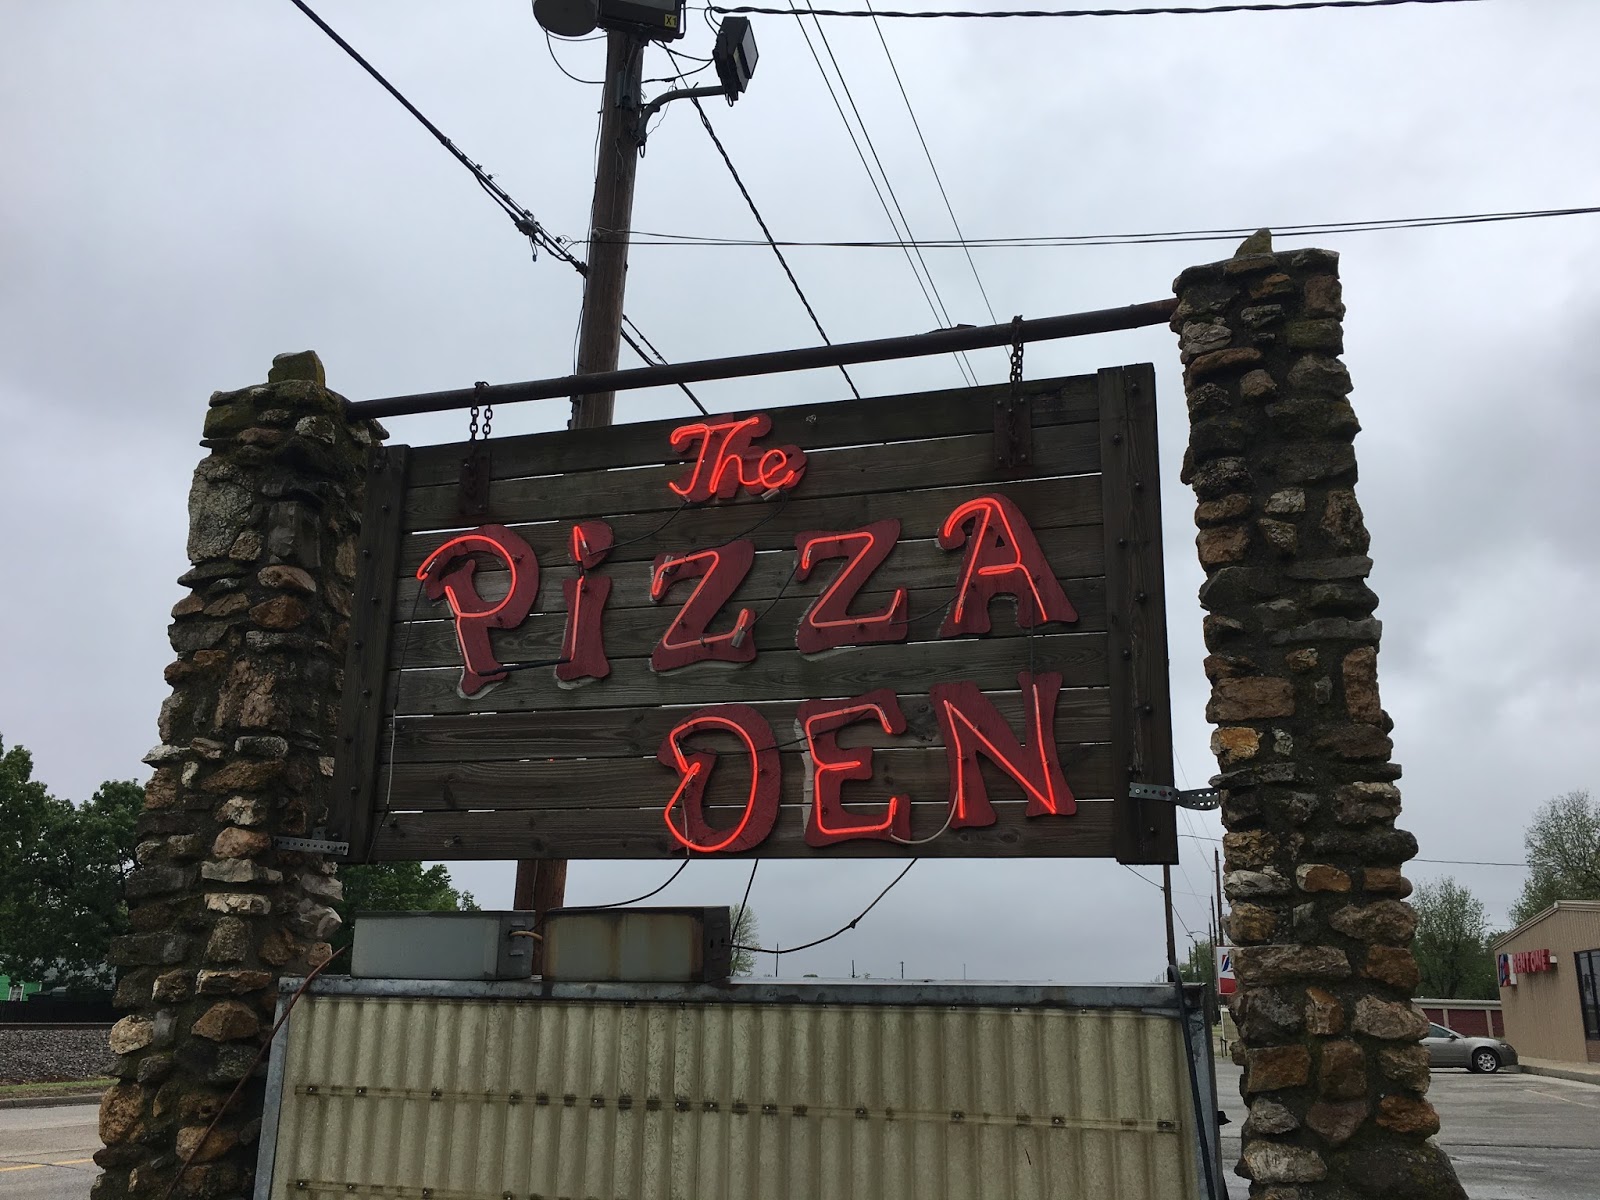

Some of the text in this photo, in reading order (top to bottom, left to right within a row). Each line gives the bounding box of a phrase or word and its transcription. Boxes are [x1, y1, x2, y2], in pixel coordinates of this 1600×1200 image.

[669, 413, 806, 501] The
[657, 672, 1078, 853] DEN
[1513, 949, 1549, 974] RENT ONE
